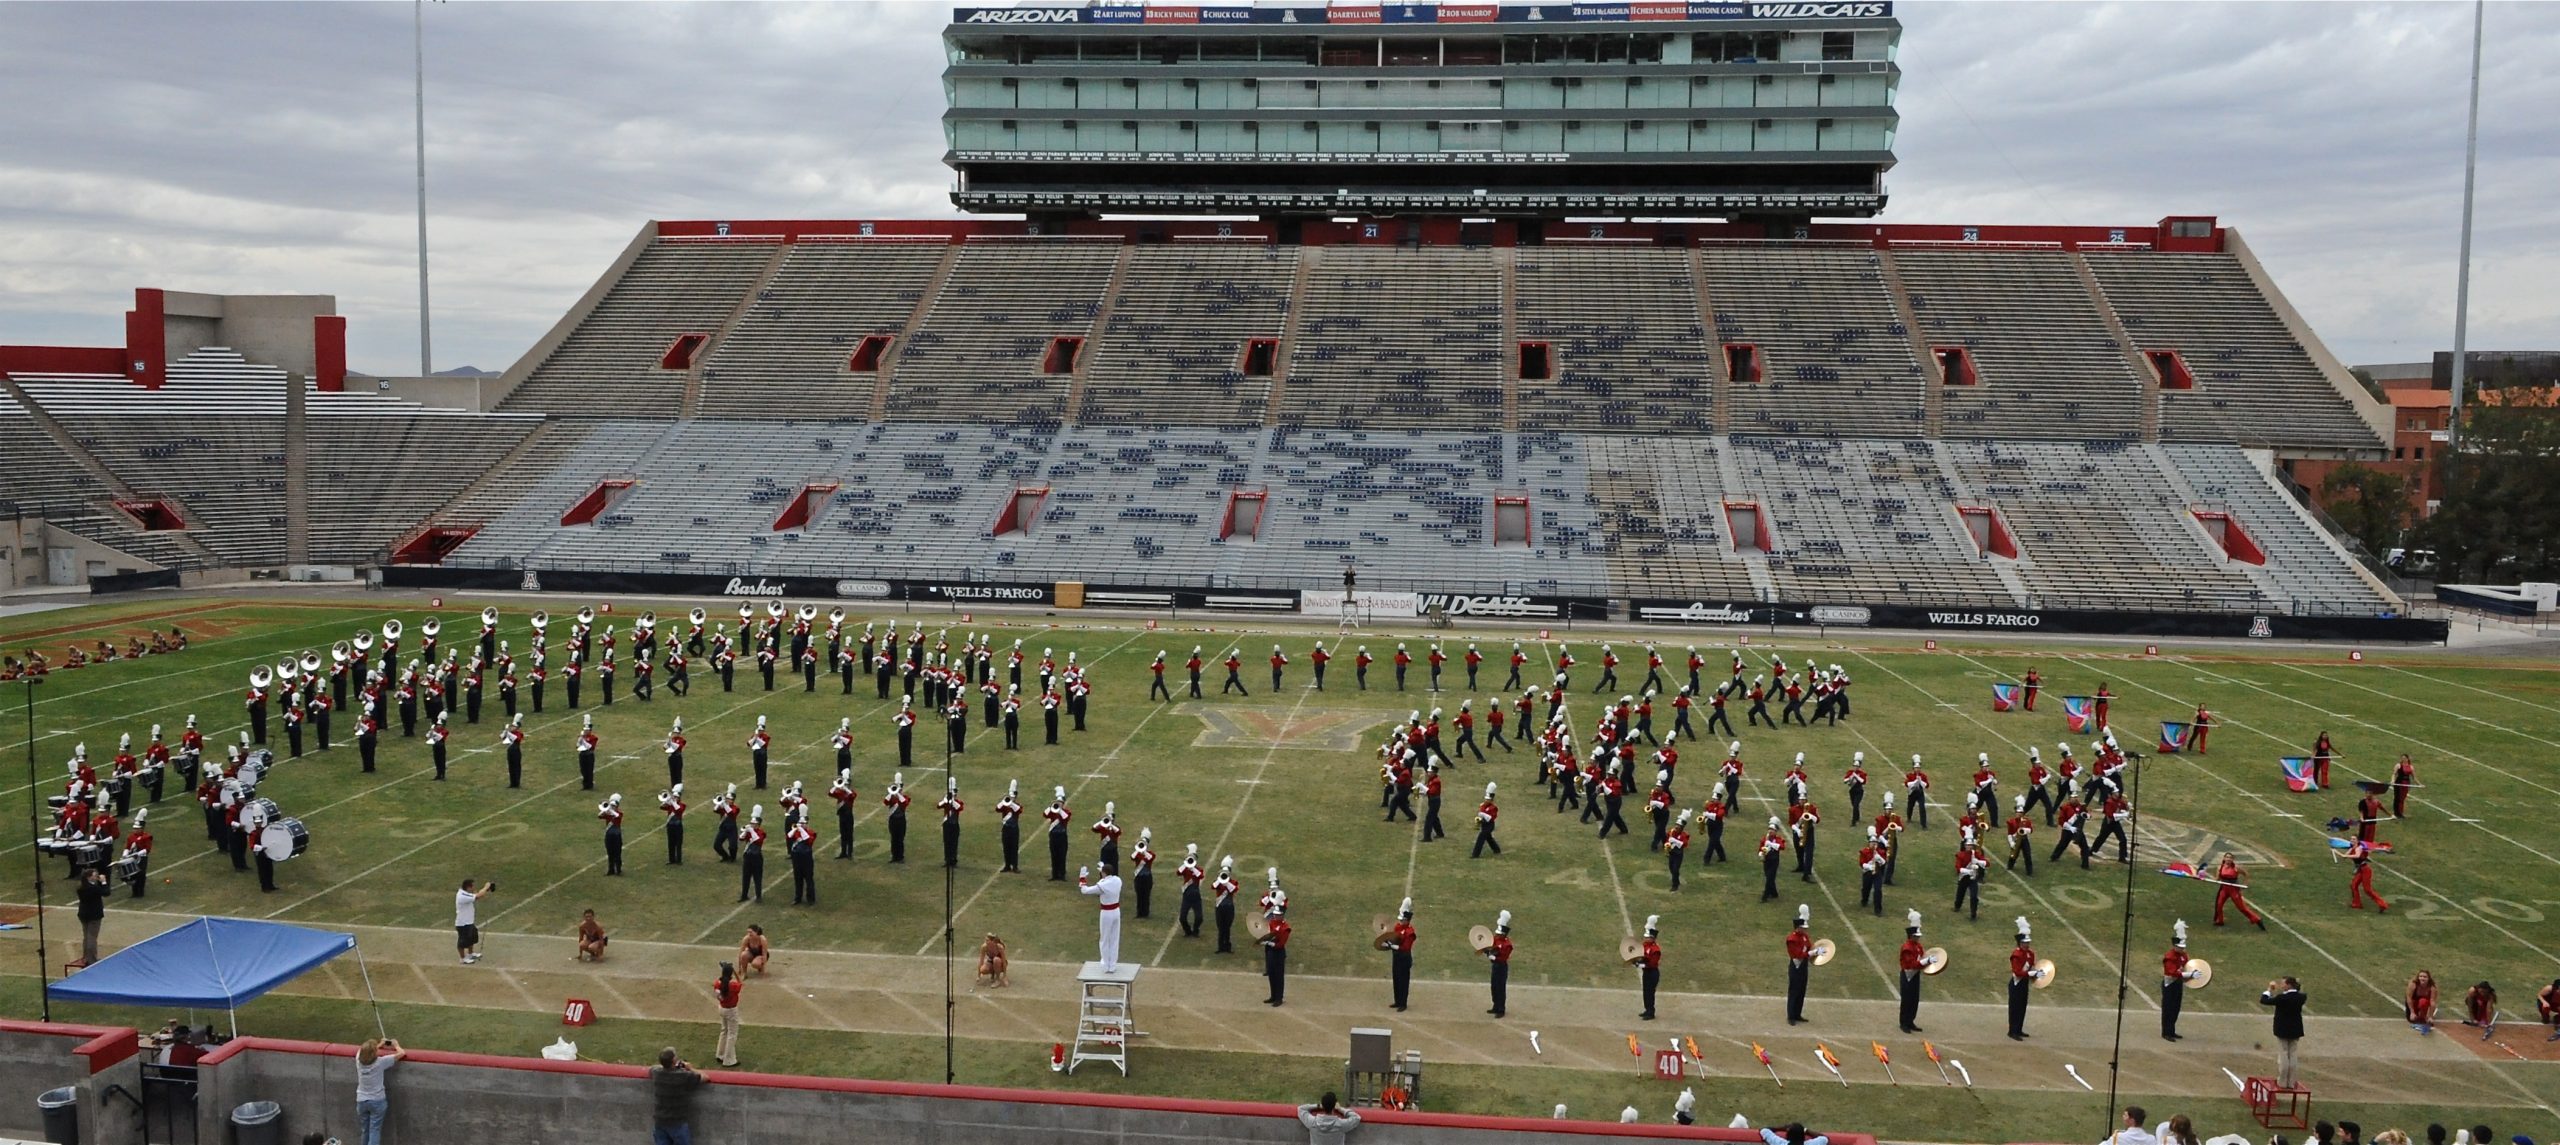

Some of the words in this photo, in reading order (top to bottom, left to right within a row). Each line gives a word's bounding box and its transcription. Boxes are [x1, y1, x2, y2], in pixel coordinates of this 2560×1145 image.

[1093, 10, 1101, 18] 22
[1203, 10, 1208, 18] 6
[1688, 6, 1692, 14] 5
[1752, 4, 1886, 17] WILDCATS
[966, 10, 1079, 23] ARIZONA
[718, 227, 728, 236] 17
[862, 227, 872, 236] 18
[1028, 227, 1039, 236] 19
[1218, 227, 1232, 236] 20
[1366, 228, 1376, 237] 21
[1590, 229, 1603, 238] 22
[1794, 230, 1808, 240] 23
[1964, 232, 1977, 241] 24
[2110, 234, 2124, 242] 25
[134, 362, 144, 370] 15
[521, 571, 541, 590] A
[724, 577, 786, 596] Bashas'
[943, 586, 992, 598] WELLS
[994, 588, 1043, 600] FARGO
[1381, 600, 1400, 608] BAND
[1401, 600, 1414, 608] DAY
[1928, 613, 1982, 624] WELLS
[1986, 614, 2040, 626] FARGO
[2249, 616, 2272, 638] A
[566, 1002, 584, 1022] 40
[1660, 1054, 1679, 1076] 40
